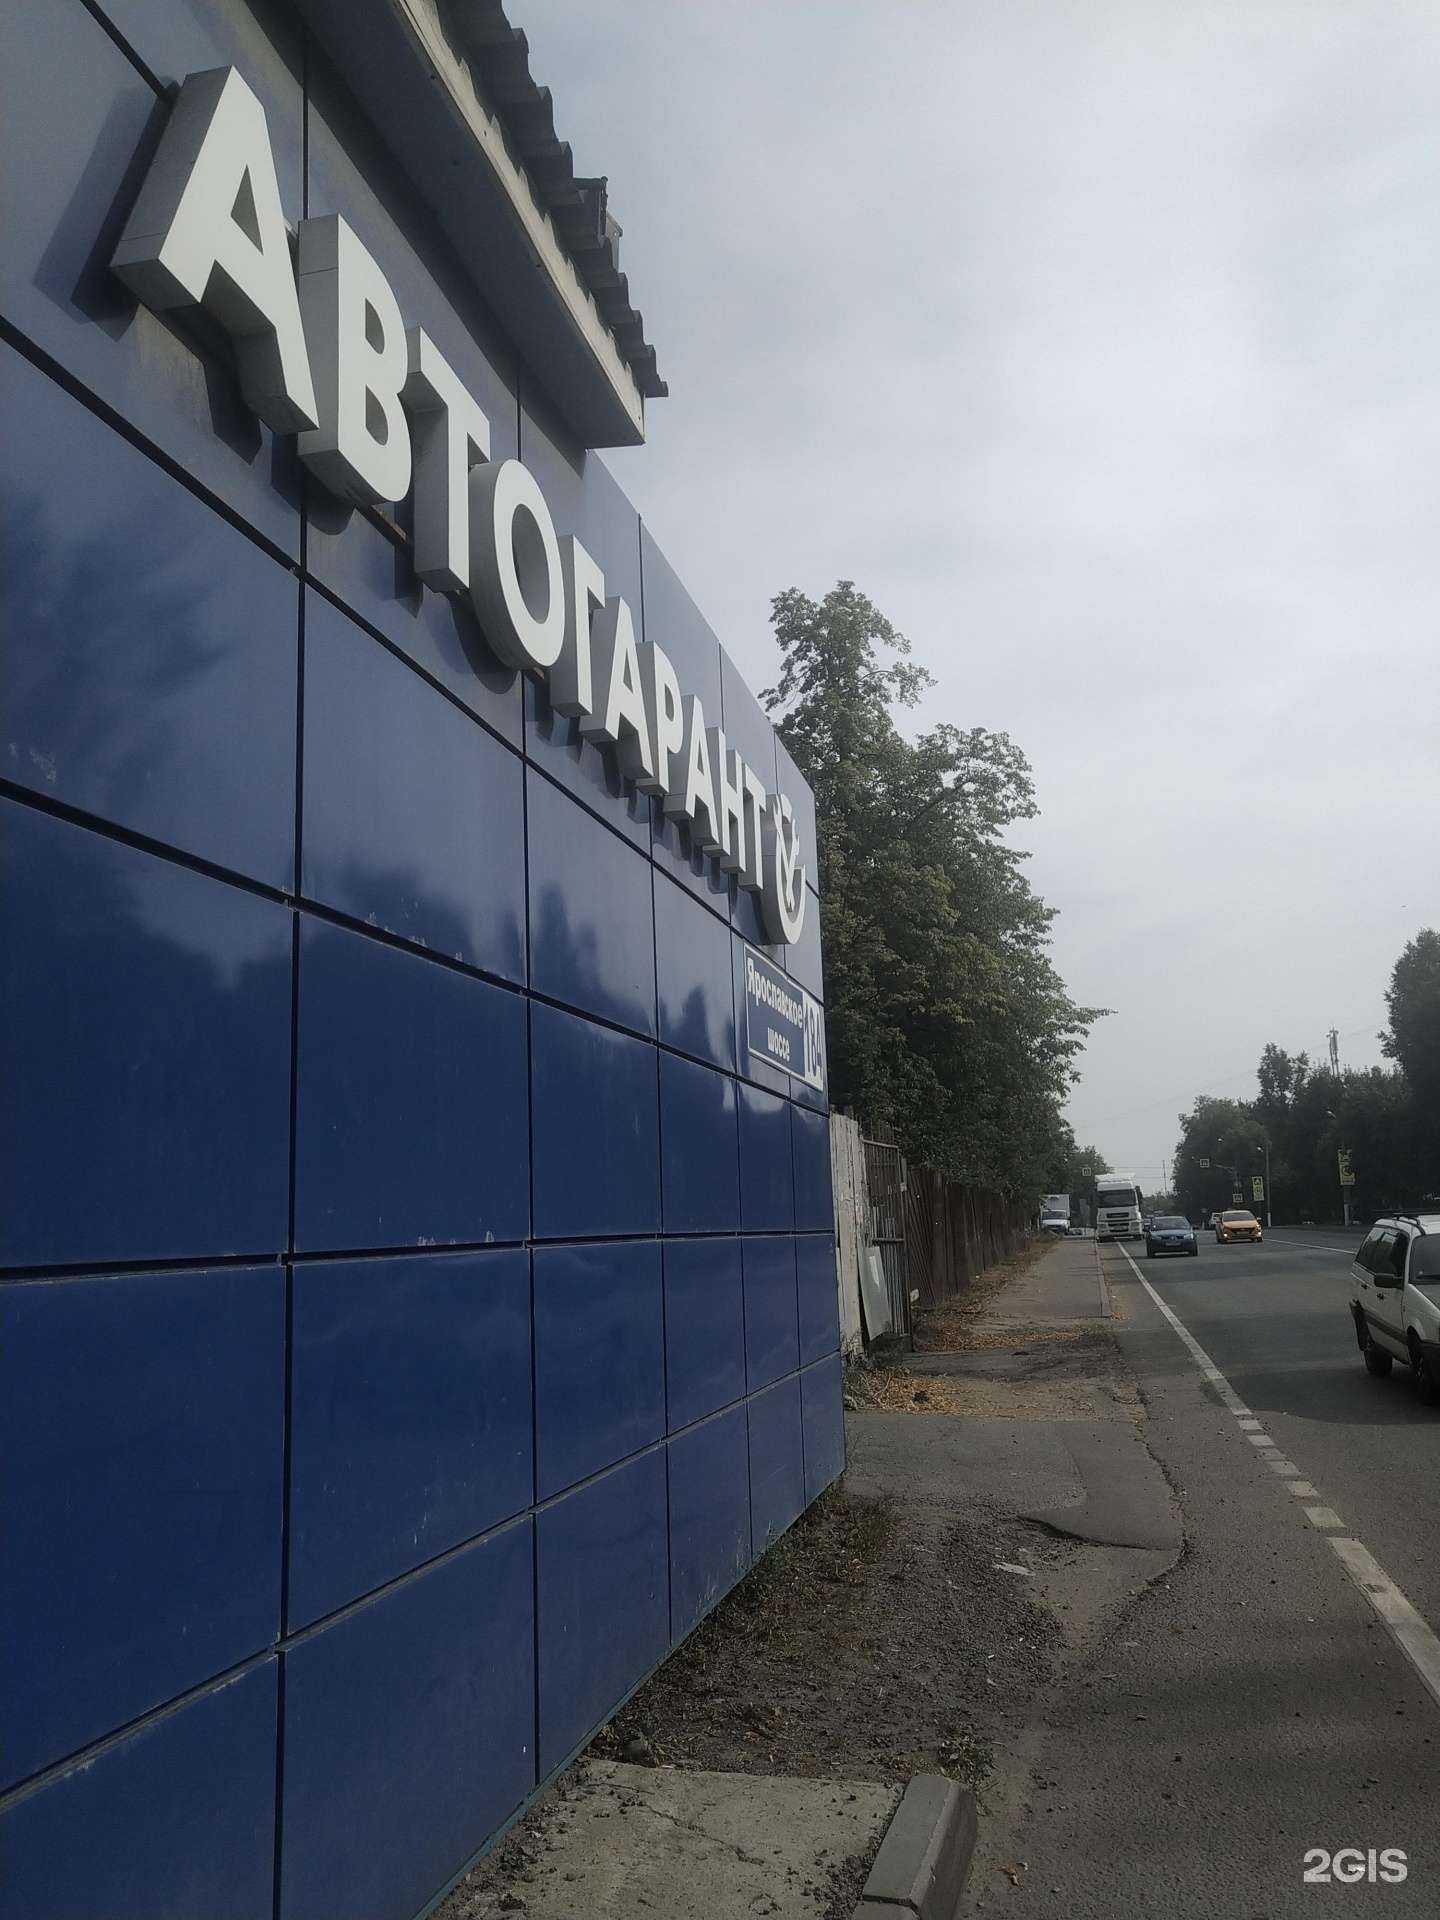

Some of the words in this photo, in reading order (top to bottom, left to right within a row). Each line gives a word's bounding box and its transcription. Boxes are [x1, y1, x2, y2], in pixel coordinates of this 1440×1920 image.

[155, 65, 768, 891] АВТОГАРАНТ
[747, 956, 803, 1029] Ярославское
[767, 1027, 790, 1062] шоссе
